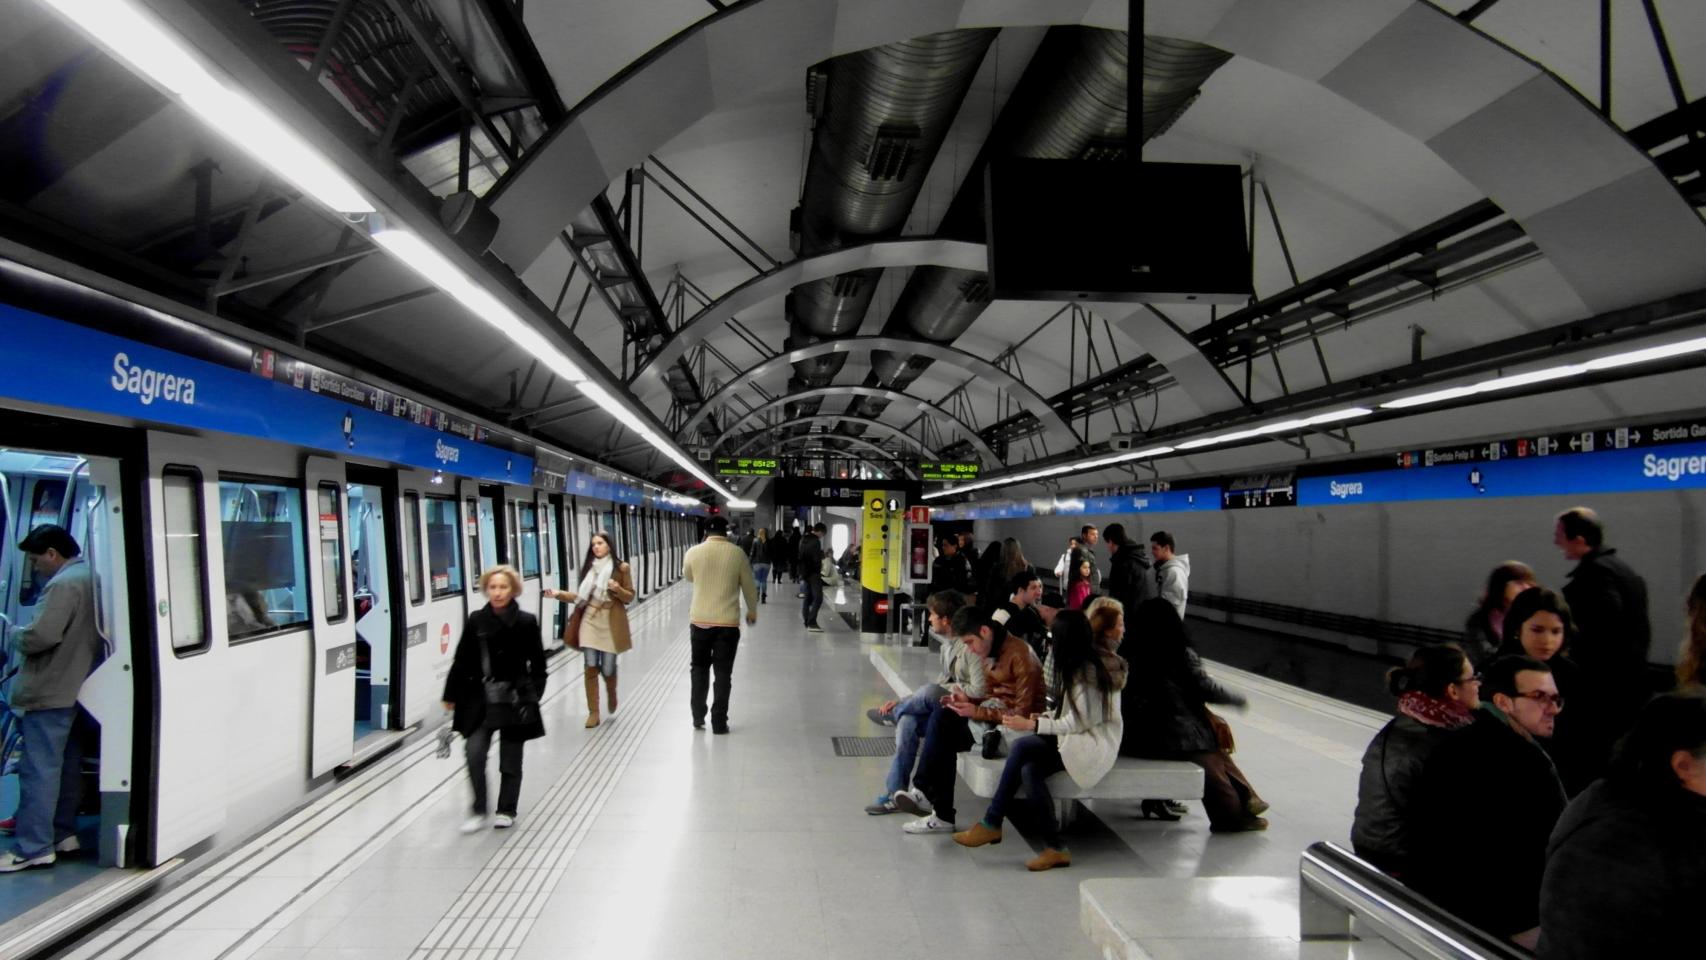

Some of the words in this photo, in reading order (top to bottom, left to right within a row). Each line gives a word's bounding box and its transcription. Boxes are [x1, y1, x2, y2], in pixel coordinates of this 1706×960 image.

[111, 352, 195, 405] Sagrera
[1652, 427, 1688, 441] Sortida
[436, 438, 459, 464] Sagrera
[753, 460, 776, 468] 05:25
[1330, 480, 1363, 499] Sagrera
